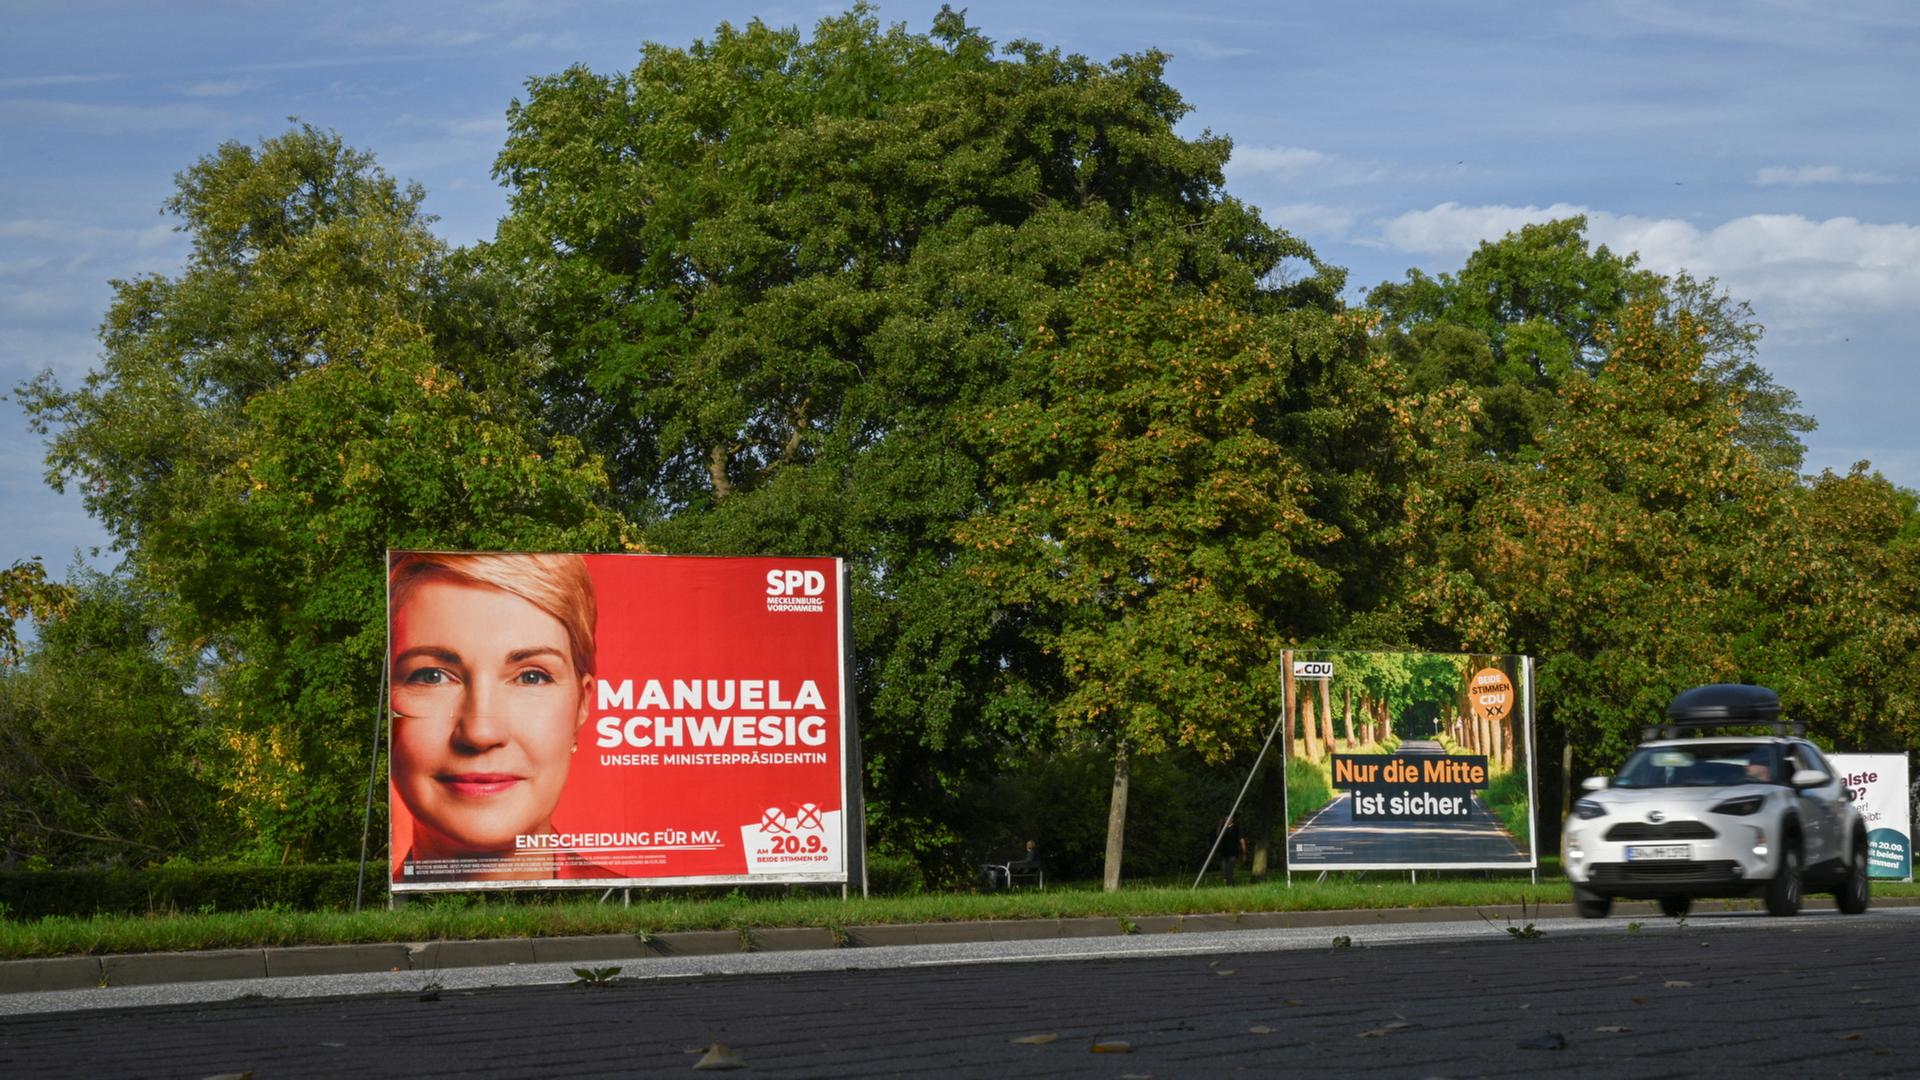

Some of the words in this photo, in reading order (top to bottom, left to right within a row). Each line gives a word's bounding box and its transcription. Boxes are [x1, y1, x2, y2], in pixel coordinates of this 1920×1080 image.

[766, 569, 825, 596] SPD
[1304, 664, 1331, 674] CDU
[1478, 674, 1502, 684] BEIDE
[597, 679, 826, 710] MANUELA
[1472, 683, 1510, 694] STIMMEN
[1480, 694, 1505, 705] CDU
[596, 715, 827, 747] SCHWESIG
[600, 754, 659, 766] UNSERE
[663, 751, 827, 765] MINISTERPRÄSIDENTIN
[1335, 759, 1379, 783] Nur
[1383, 760, 1418, 783] die
[1424, 760, 1484, 784] Mitte
[1355, 790, 1385, 815] ist
[1390, 790, 1468, 815] sicher.
[515, 832, 650, 848] ENTSCHEIDUNG
[654, 828, 686, 845] FÜR
[691, 830, 721, 844] MV.
[770, 835, 828, 854] 20.9.
[1878, 841, 1904, 852] 20.09.
[1876, 850, 1904, 861] beiden
